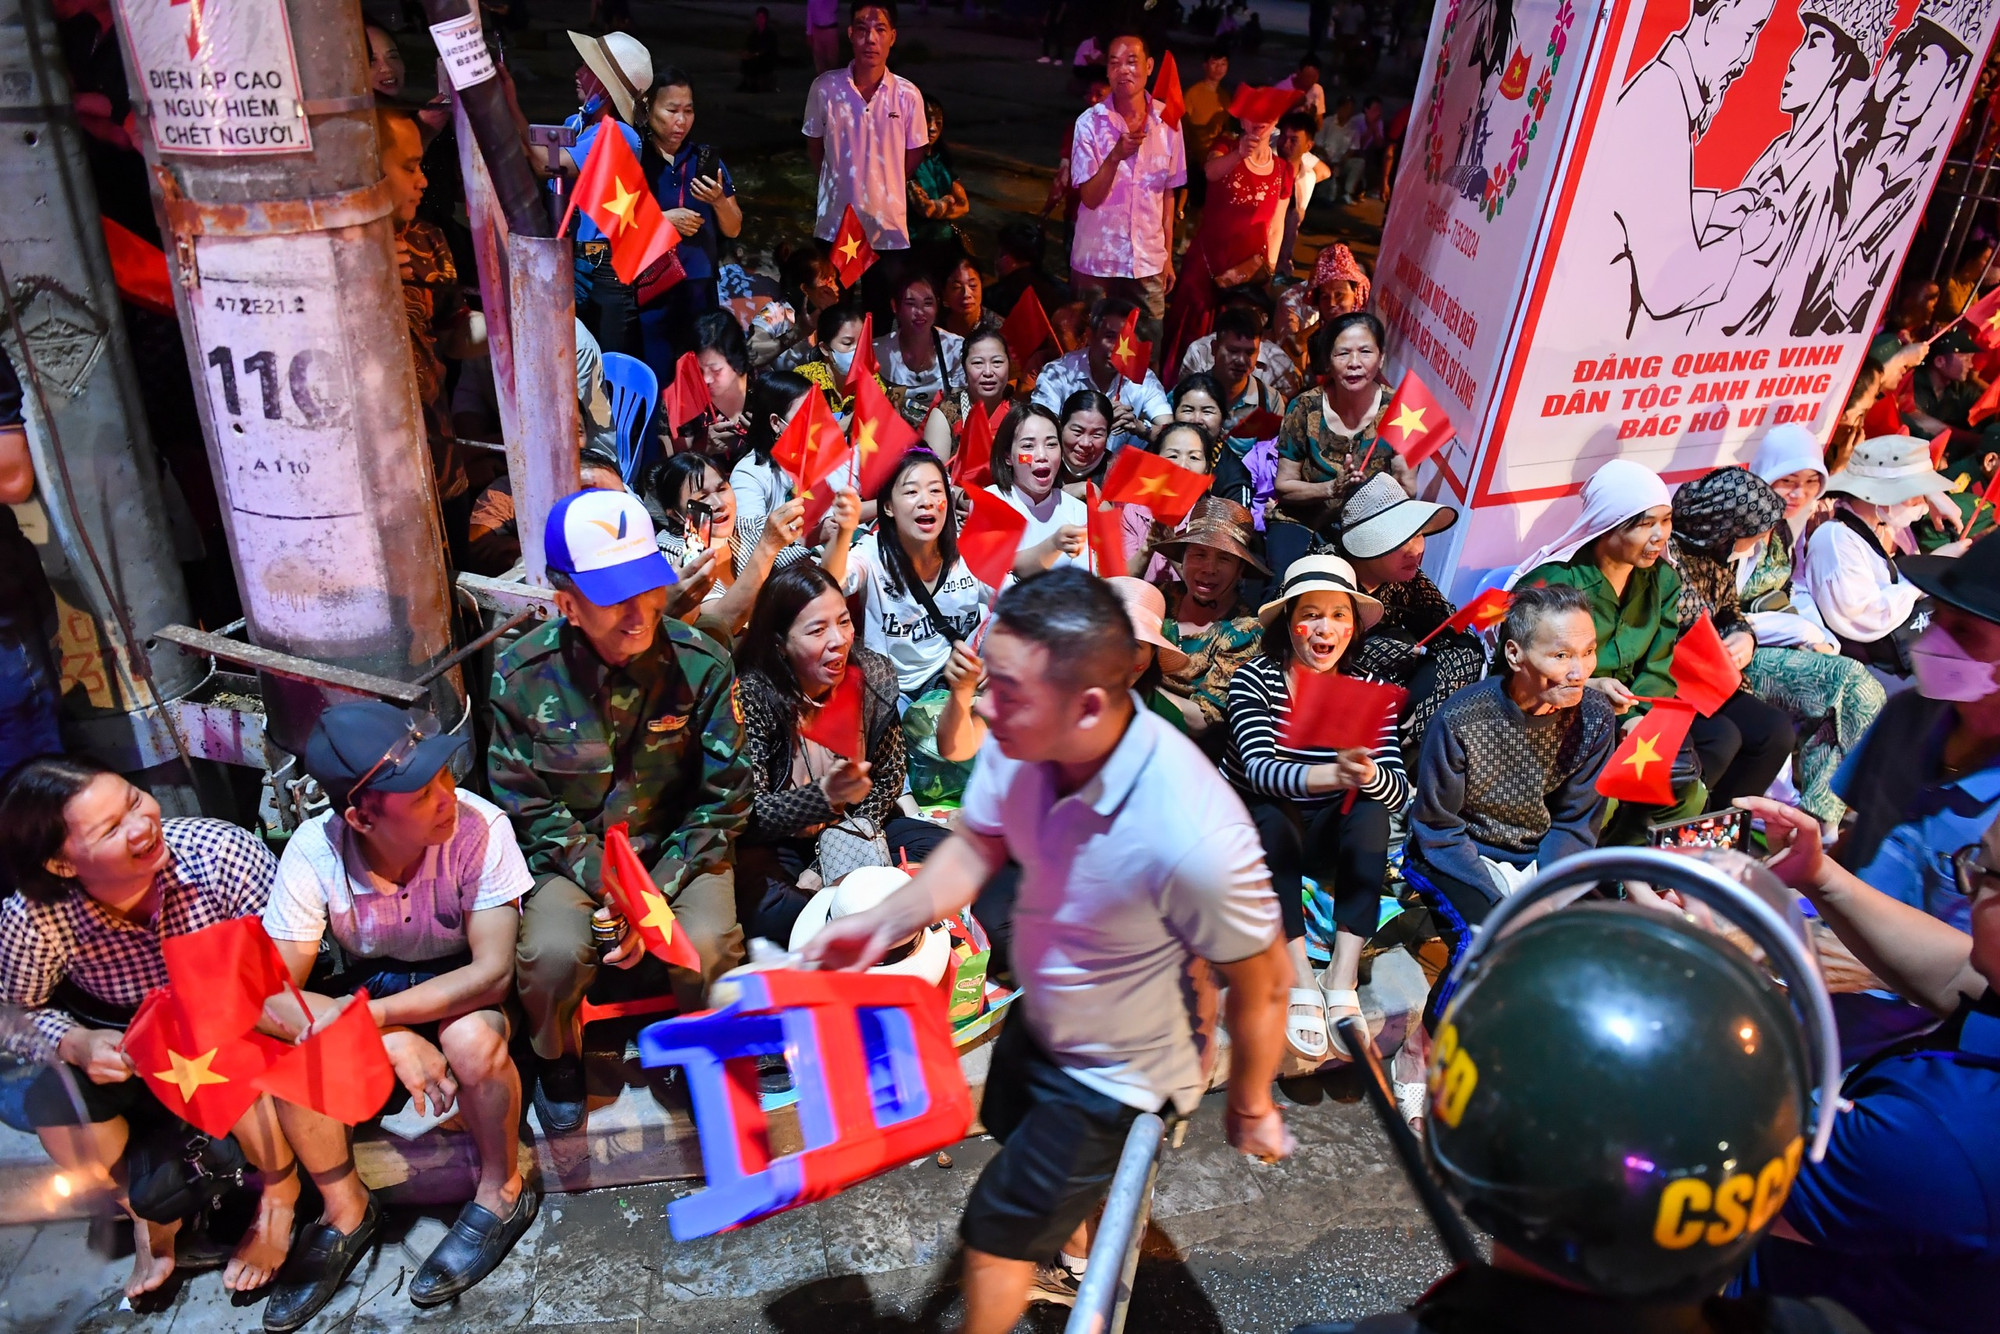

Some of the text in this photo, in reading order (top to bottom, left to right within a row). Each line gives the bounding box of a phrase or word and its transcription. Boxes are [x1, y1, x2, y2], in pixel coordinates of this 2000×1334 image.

[149, 68, 193, 94] ĐIỆN
[234, 70, 282, 91] CAO
[163, 98, 218, 118] NGUY
[219, 121, 294, 145] NGƯỜI
[1451, 219, 1480, 261] 7/5/2024
[1458, 310, 1478, 350] BIÊN
[1572, 344, 1844, 383] ĐẢNG QUANG VINH
[208, 346, 350, 428] 110
[1455, 366, 1477, 411] VÀNG
[1540, 372, 1832, 417] DÂN TỘC ANH HÙNG
[1616, 413, 1682, 440] BÁC
[1688, 402, 1731, 433] HỒ
[1773, 402, 1821, 425] ĐẠI
[254, 459, 310, 475] A110
